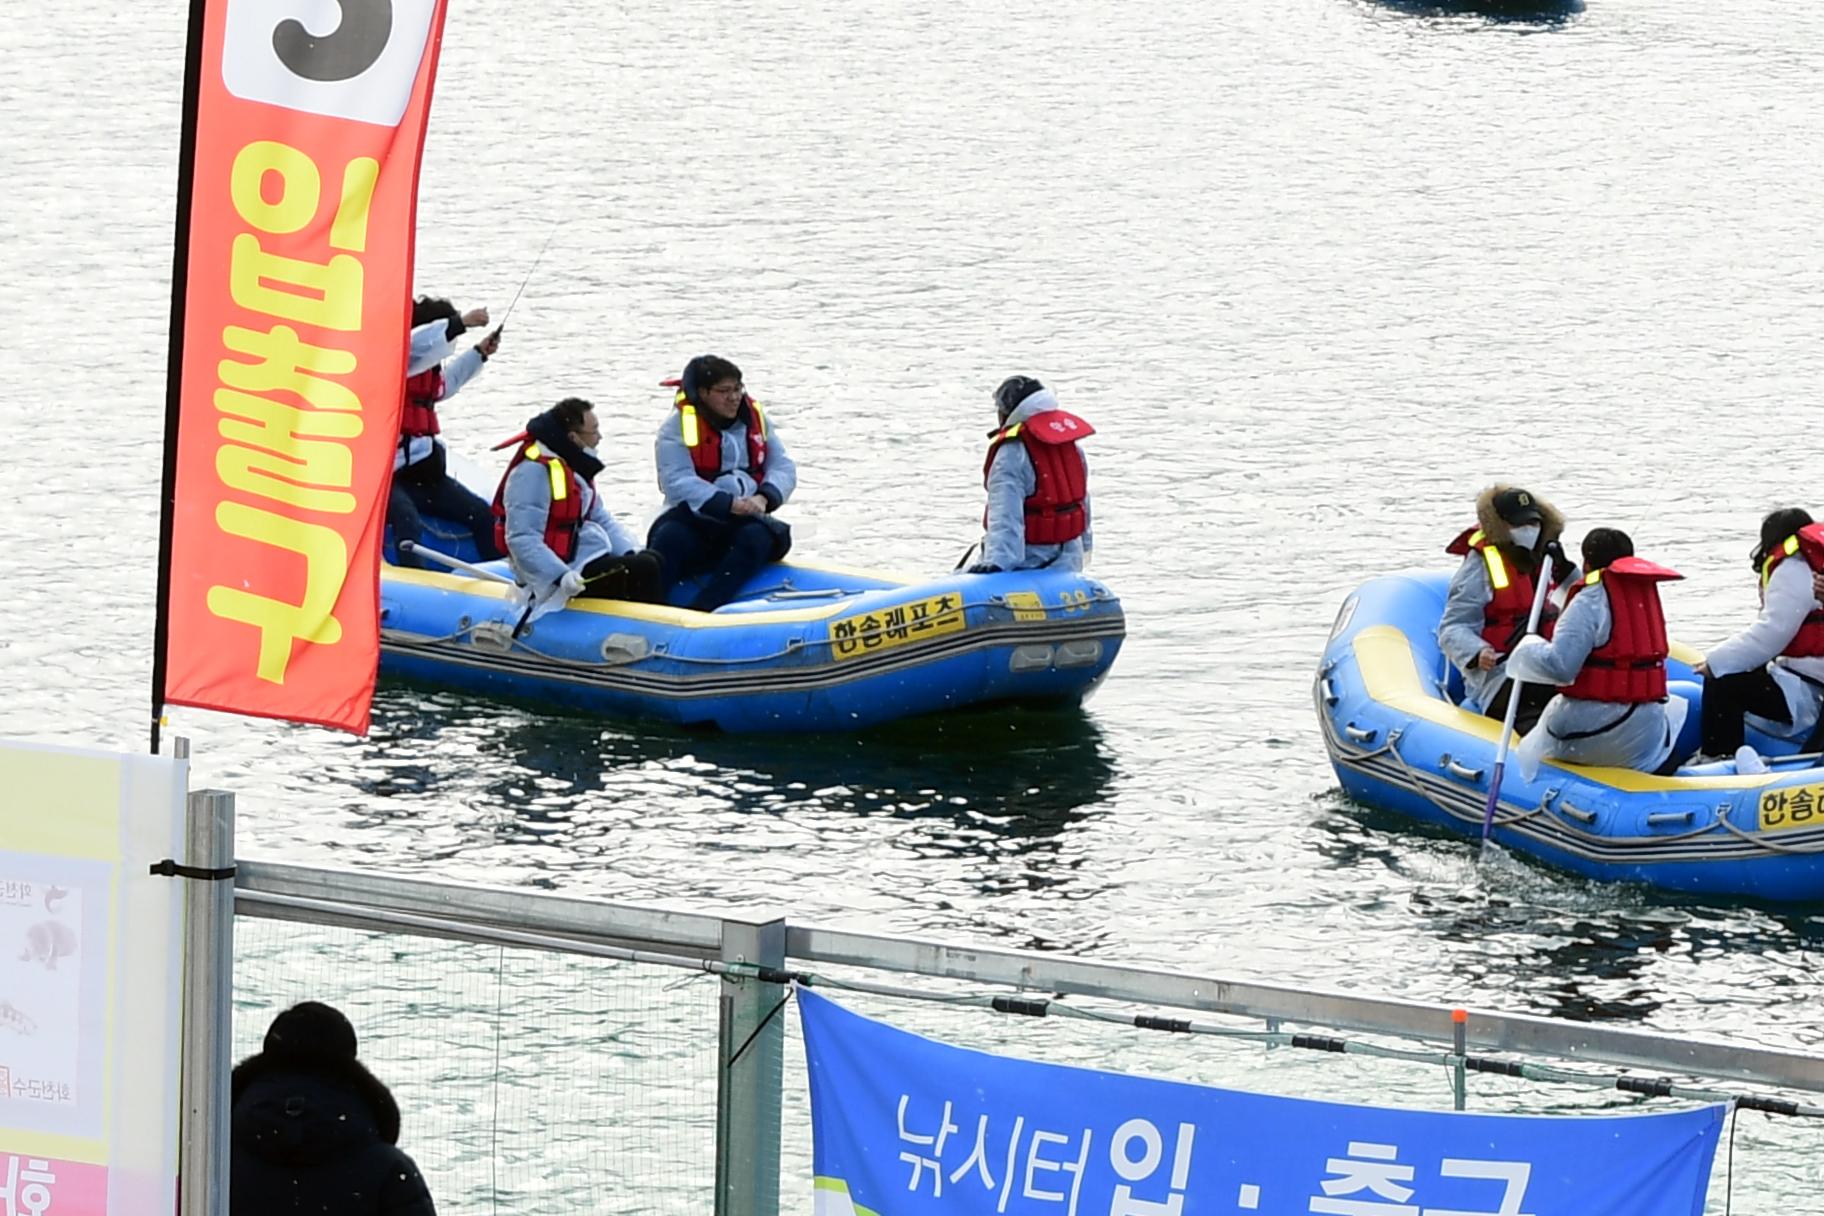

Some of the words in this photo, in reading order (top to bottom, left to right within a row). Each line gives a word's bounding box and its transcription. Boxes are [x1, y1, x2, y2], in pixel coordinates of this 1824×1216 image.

[206, 140, 378, 685] 입출구
[833, 594, 959, 654] 한송레포츠
[889, 1095, 1092, 1216] 낚시터
